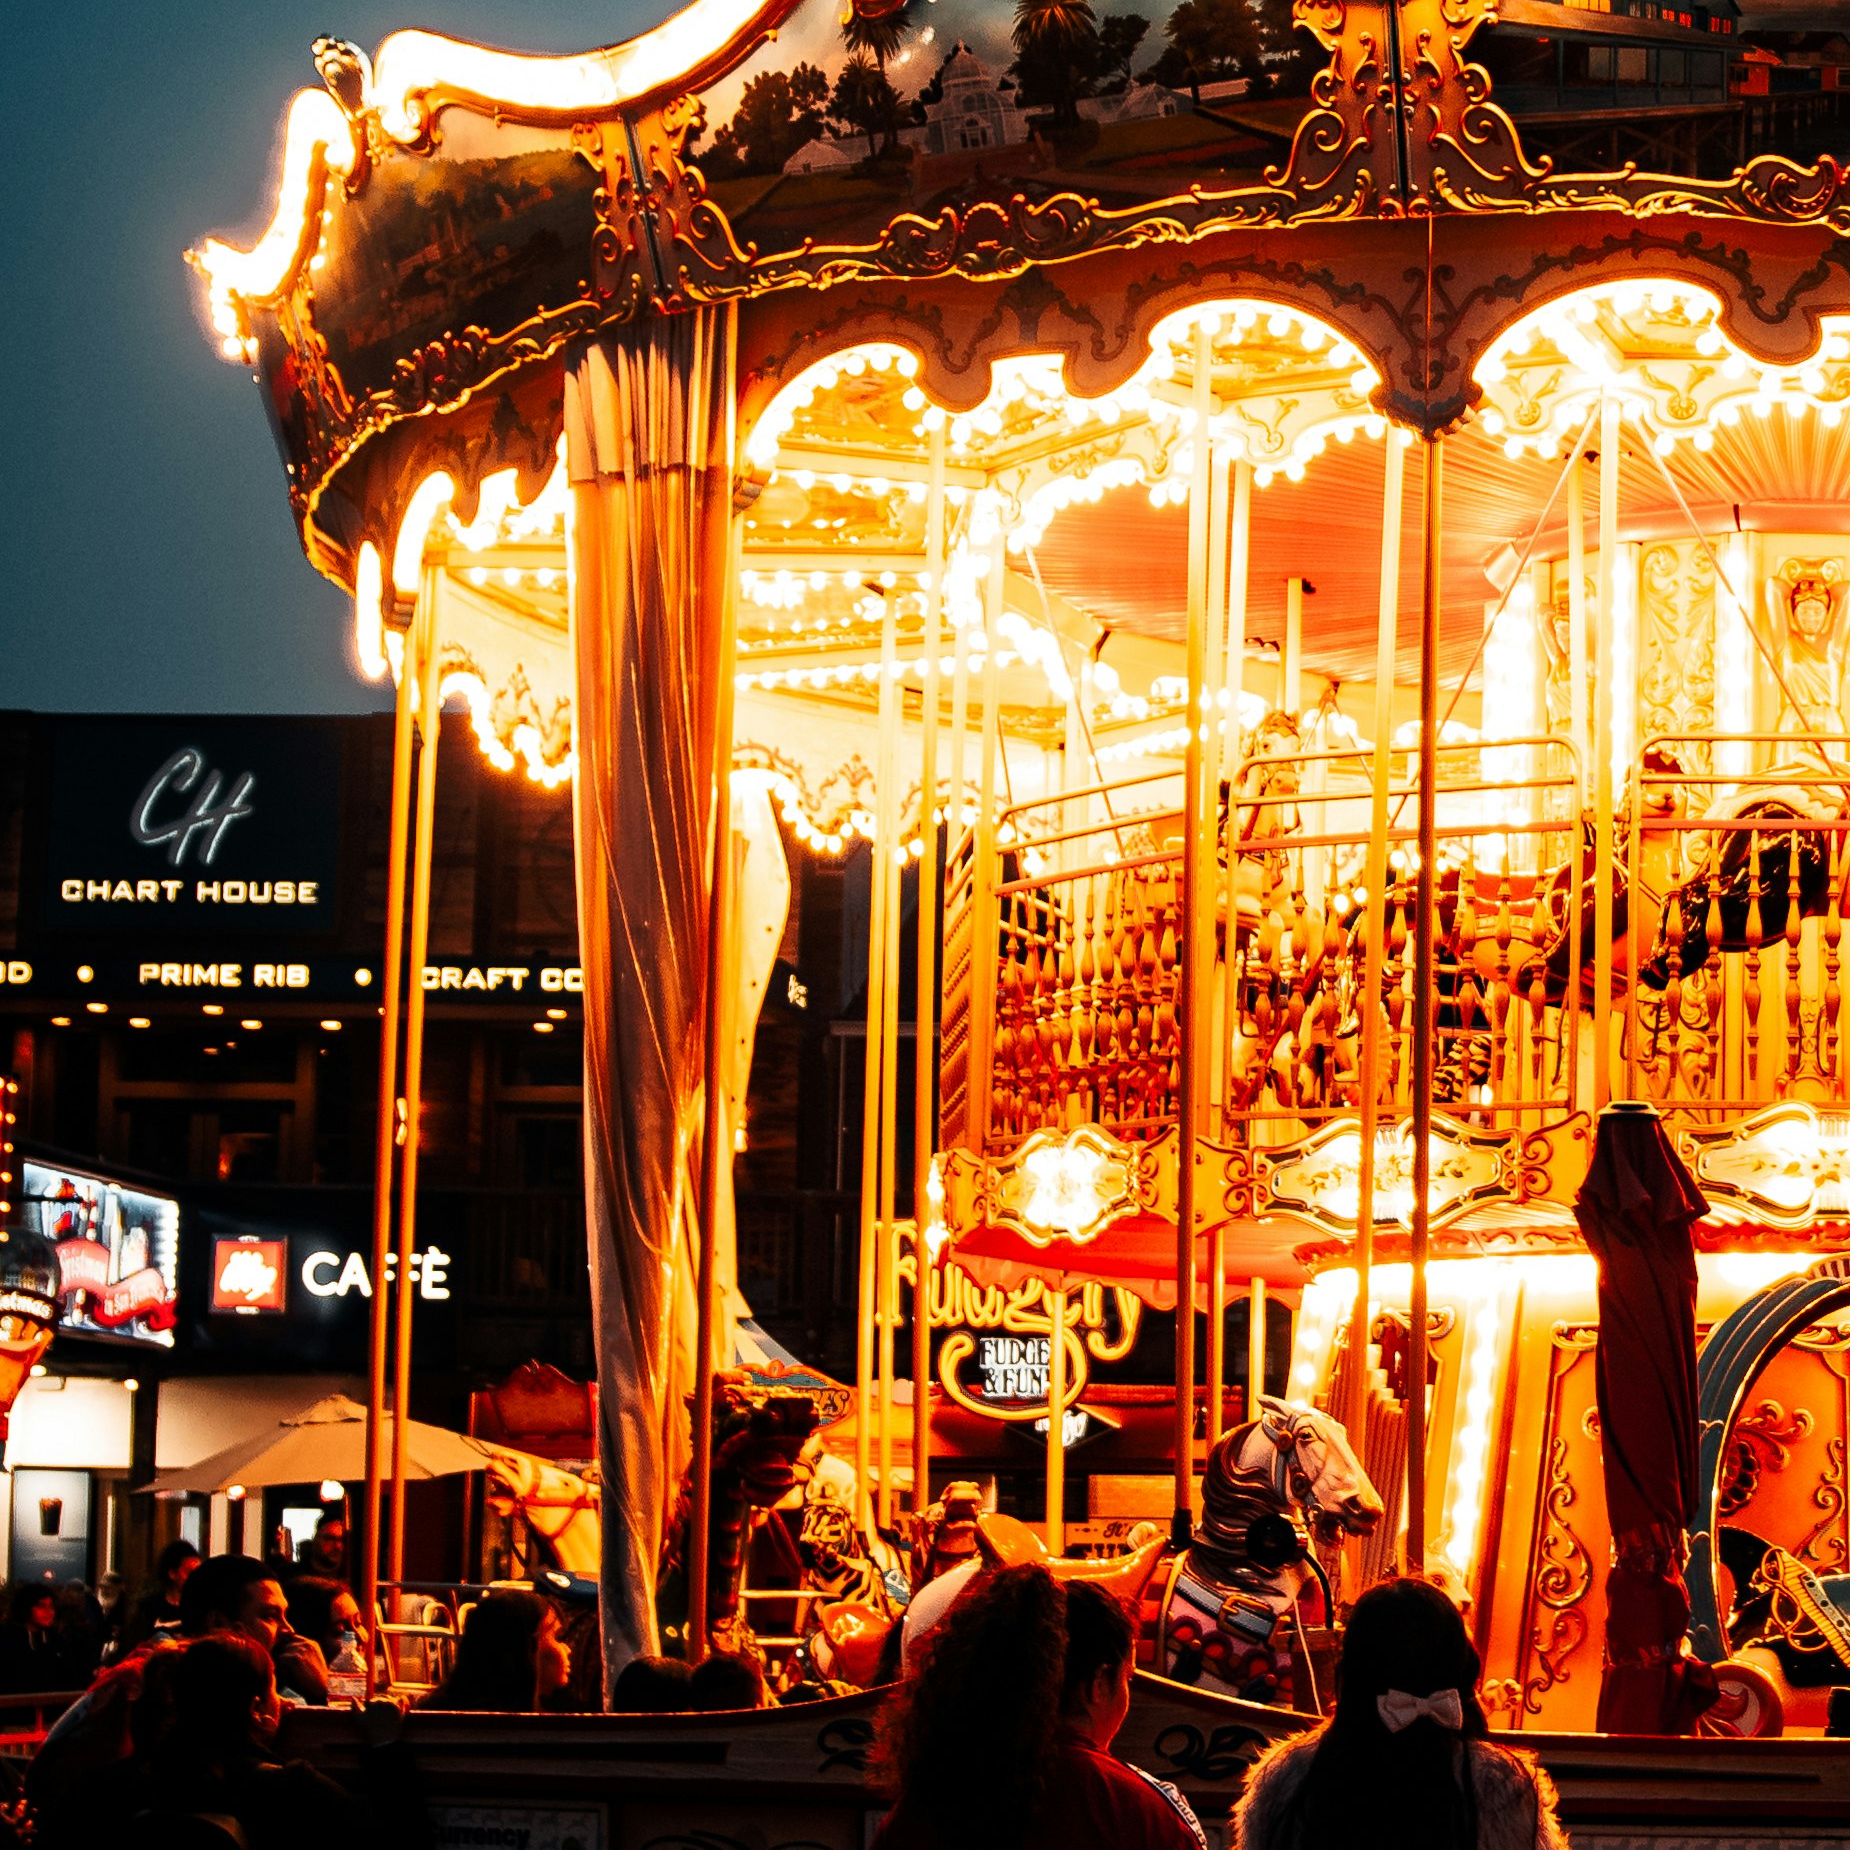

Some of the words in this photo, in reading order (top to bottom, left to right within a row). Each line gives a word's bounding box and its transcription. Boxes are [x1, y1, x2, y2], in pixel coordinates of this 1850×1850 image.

[61, 879, 184, 904] CHART
[196, 880, 320, 905] HOUSE
[139, 962, 242, 988] PRIME
[253, 964, 310, 988] RIB
[420, 966, 530, 992] CRAFT
[540, 967, 584, 992] CO
[980, 1337, 1050, 1366] FUDGE
[439, 1825, 530, 1850] urrency
